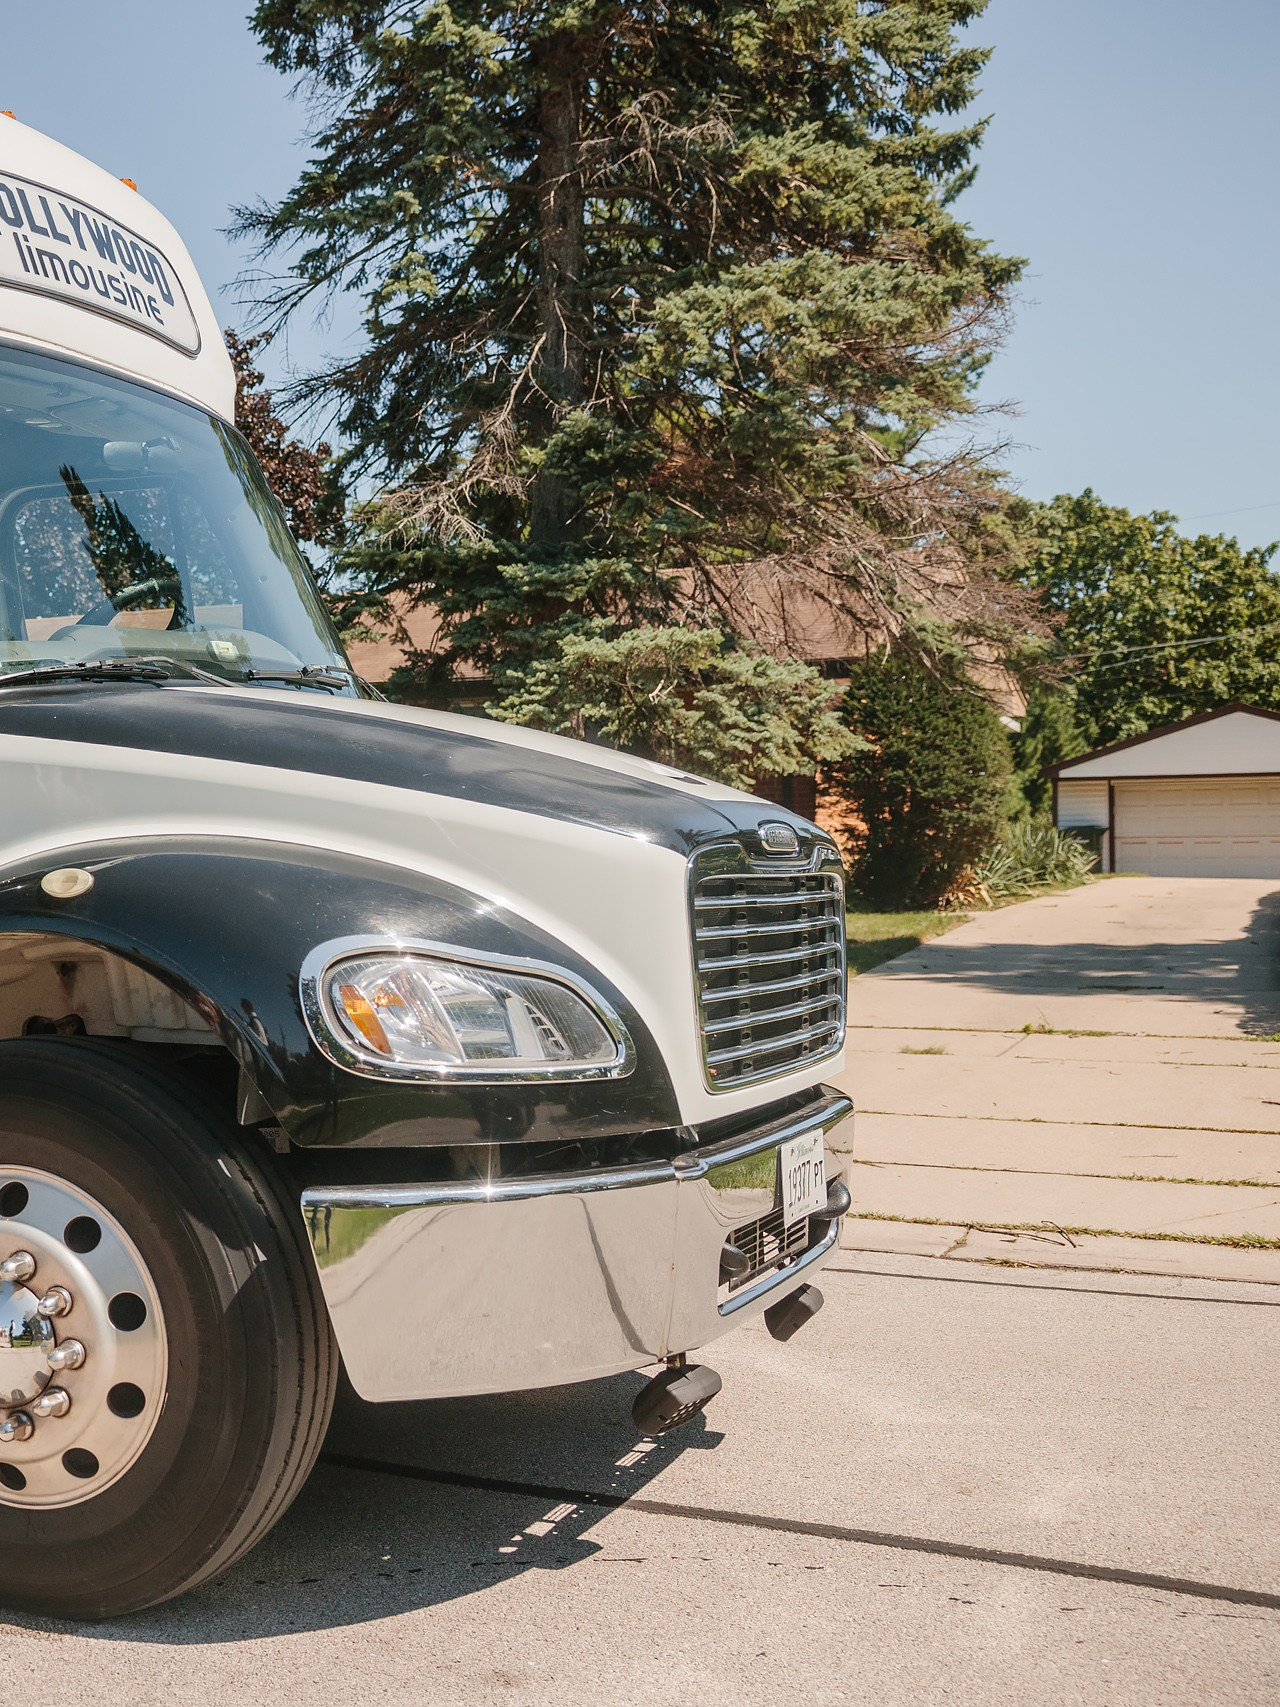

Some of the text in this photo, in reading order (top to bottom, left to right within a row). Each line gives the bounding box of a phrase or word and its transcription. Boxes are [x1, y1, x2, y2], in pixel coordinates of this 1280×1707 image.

[12, 230, 165, 327] limousine
[789, 1160, 823, 1204] 19377 PT
